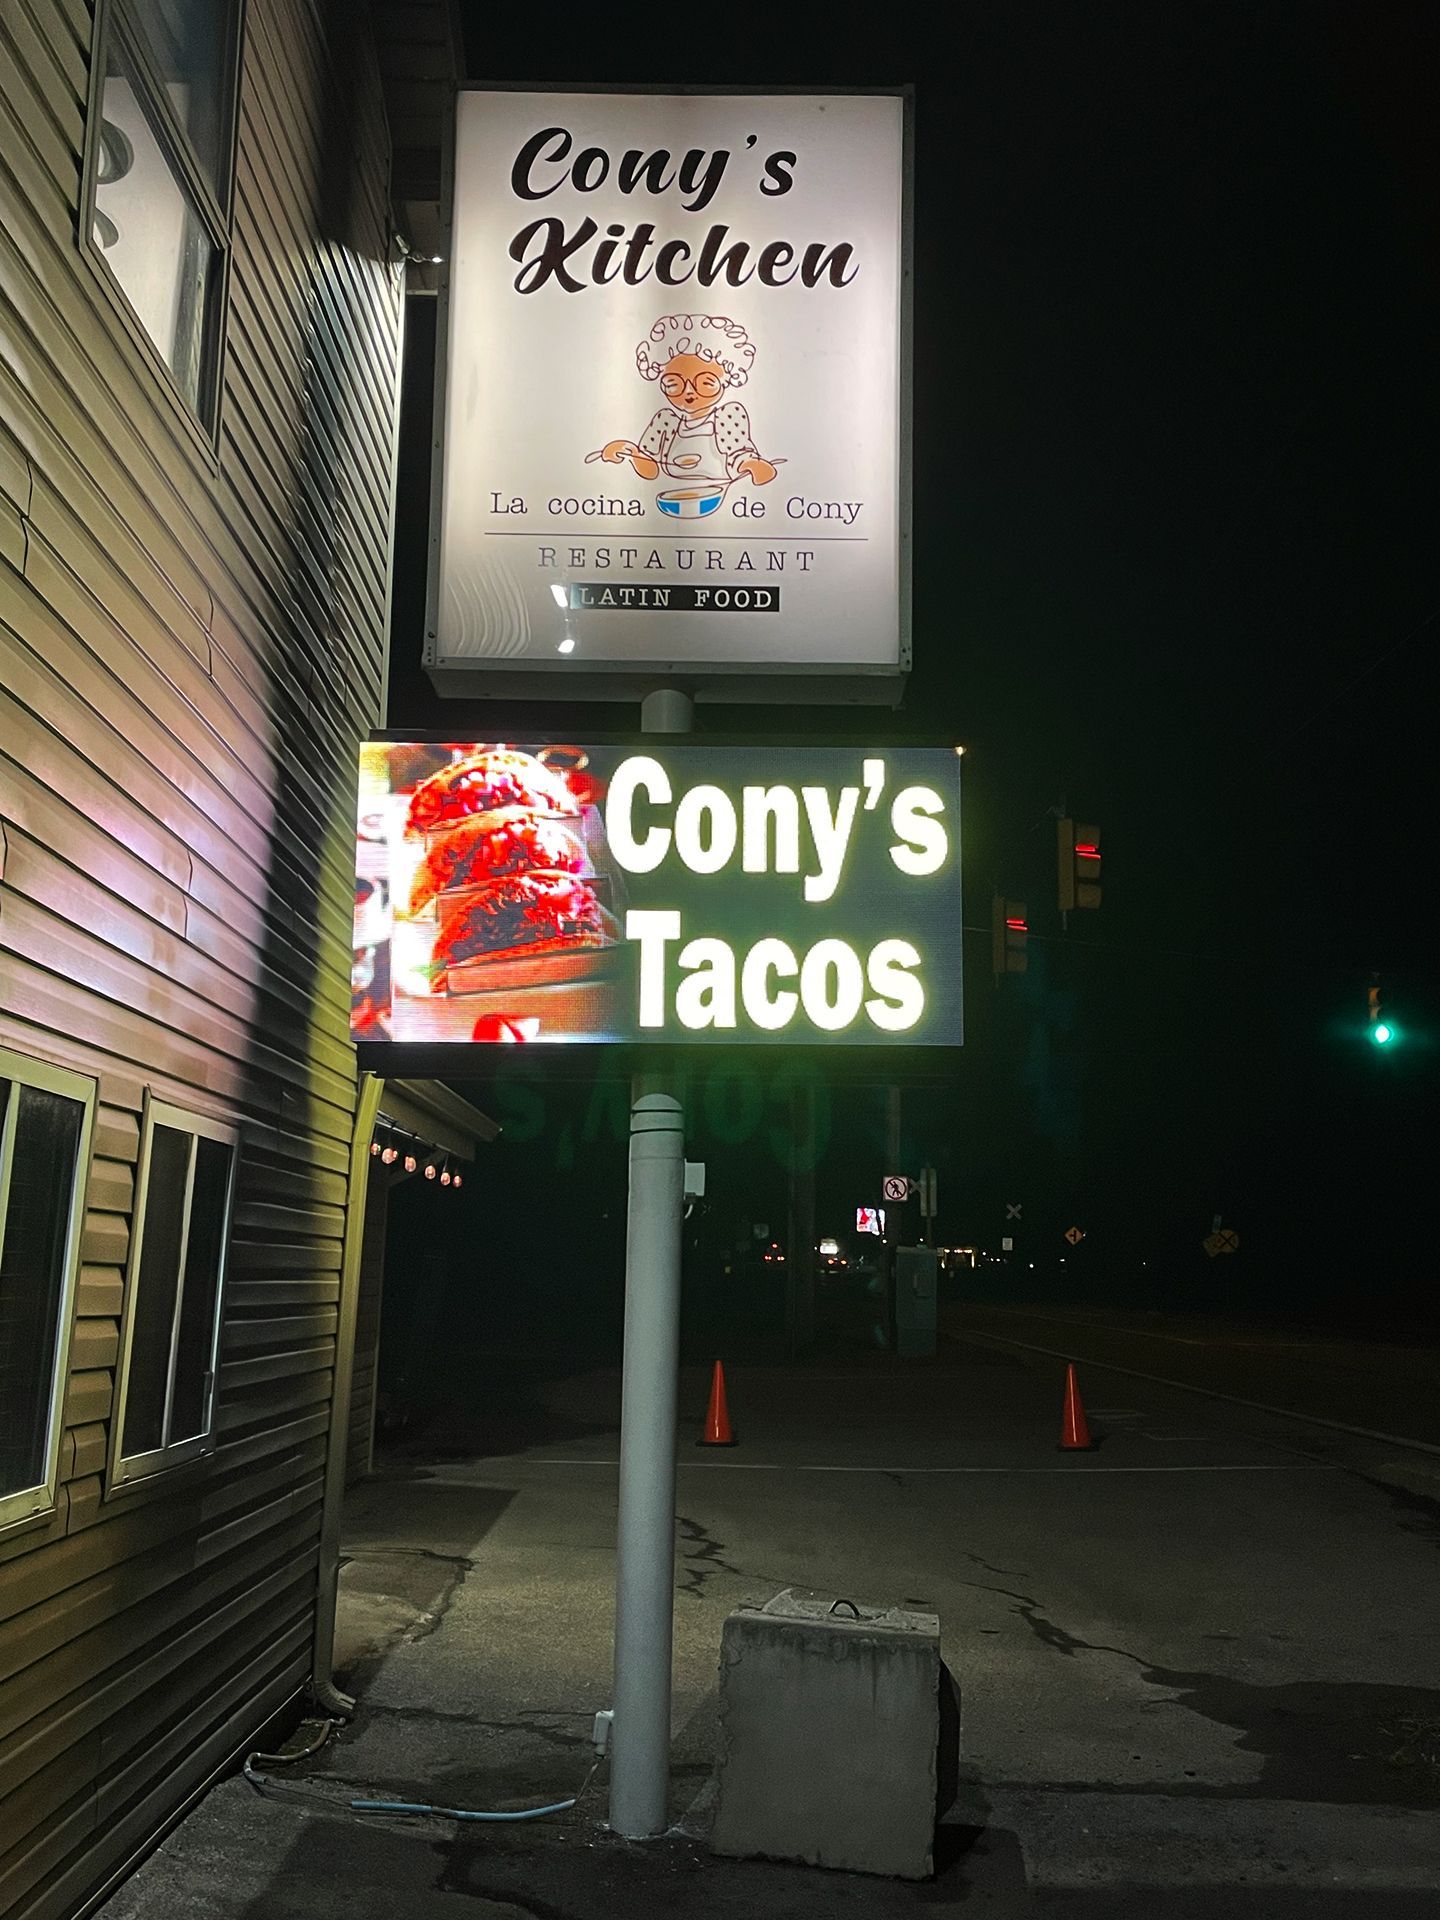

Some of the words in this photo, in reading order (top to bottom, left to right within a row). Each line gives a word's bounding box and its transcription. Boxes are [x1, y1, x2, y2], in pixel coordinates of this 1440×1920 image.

[511, 127, 797, 212] Cony's
[509, 216, 860, 294] Kitchen
[490, 492, 528, 515] La
[547, 494, 646, 517] cocina
[731, 496, 766, 519] de
[786, 496, 864, 525] Cony
[538, 547, 815, 571] RESTAURANT
[578, 587, 671, 607] LATIN
[694, 589, 772, 608] FOOD
[605, 755, 949, 902] Cony's
[625, 910, 925, 1031] Tacos
